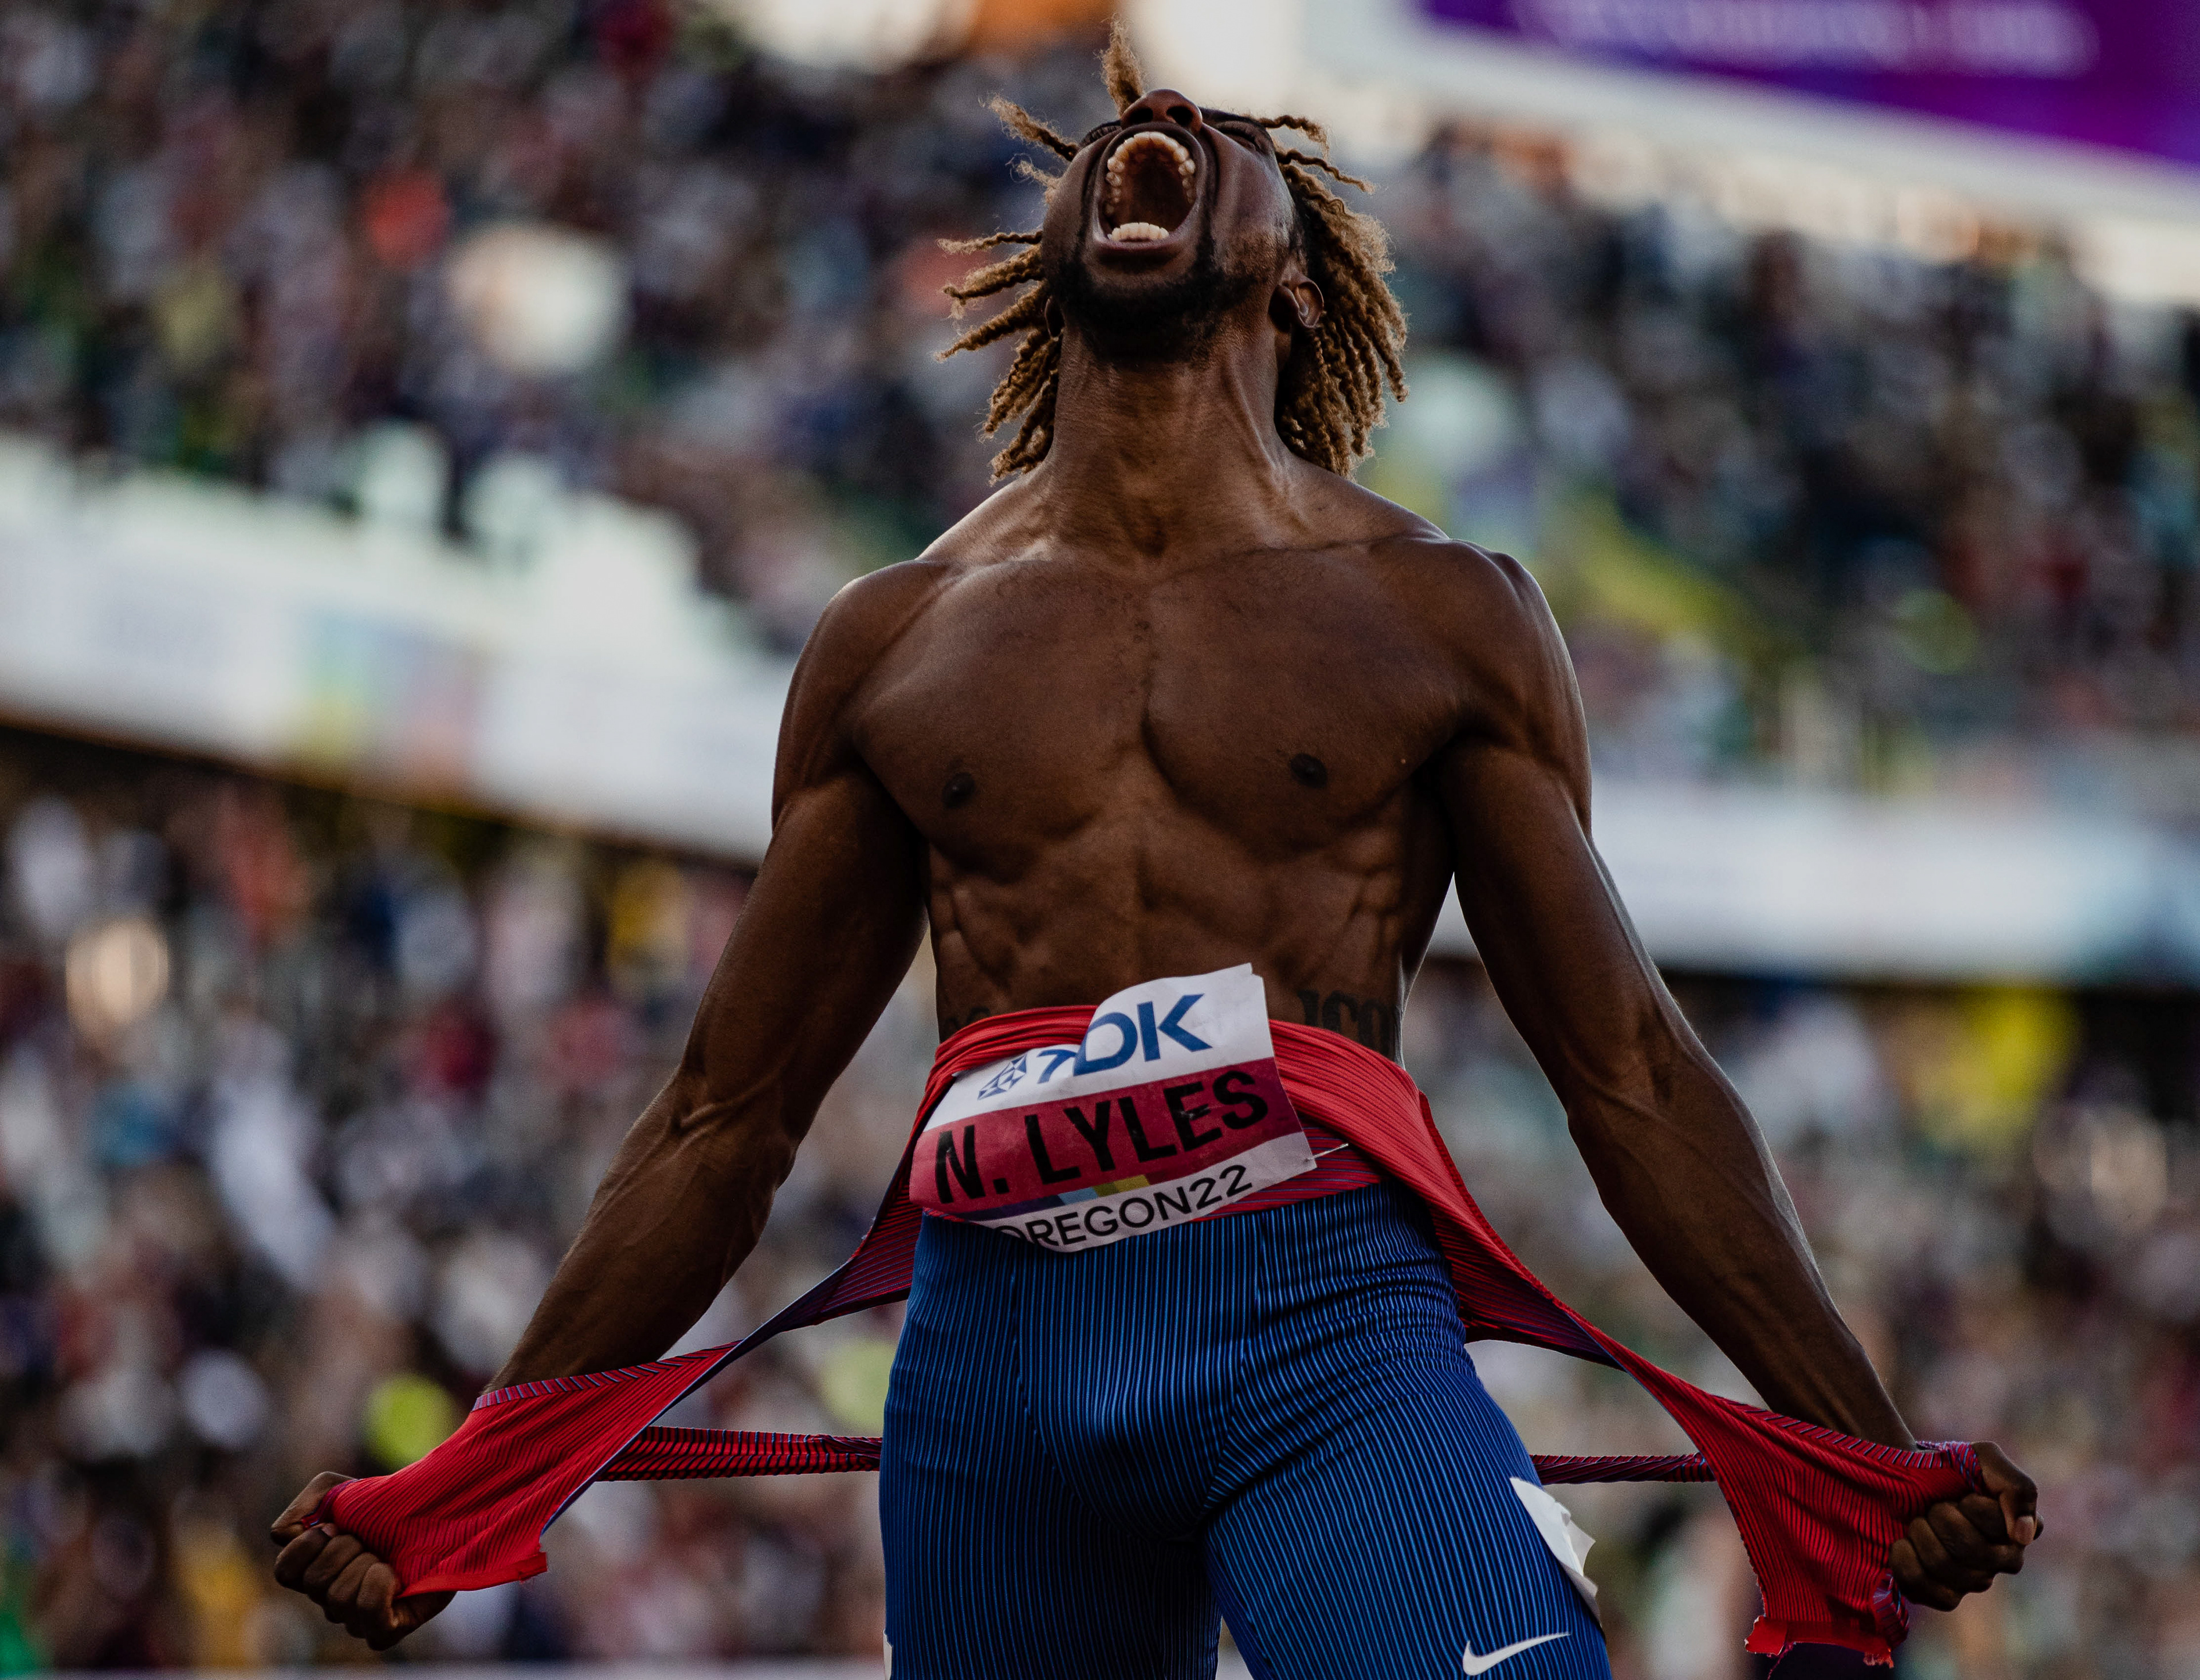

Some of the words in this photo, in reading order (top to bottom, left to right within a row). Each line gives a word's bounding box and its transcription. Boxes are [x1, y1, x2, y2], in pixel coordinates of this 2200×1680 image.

[1036, 993, 1213, 1085] TDK
[934, 1125, 1010, 1204] N.
[1024, 1070, 1268, 1186] LYLES
